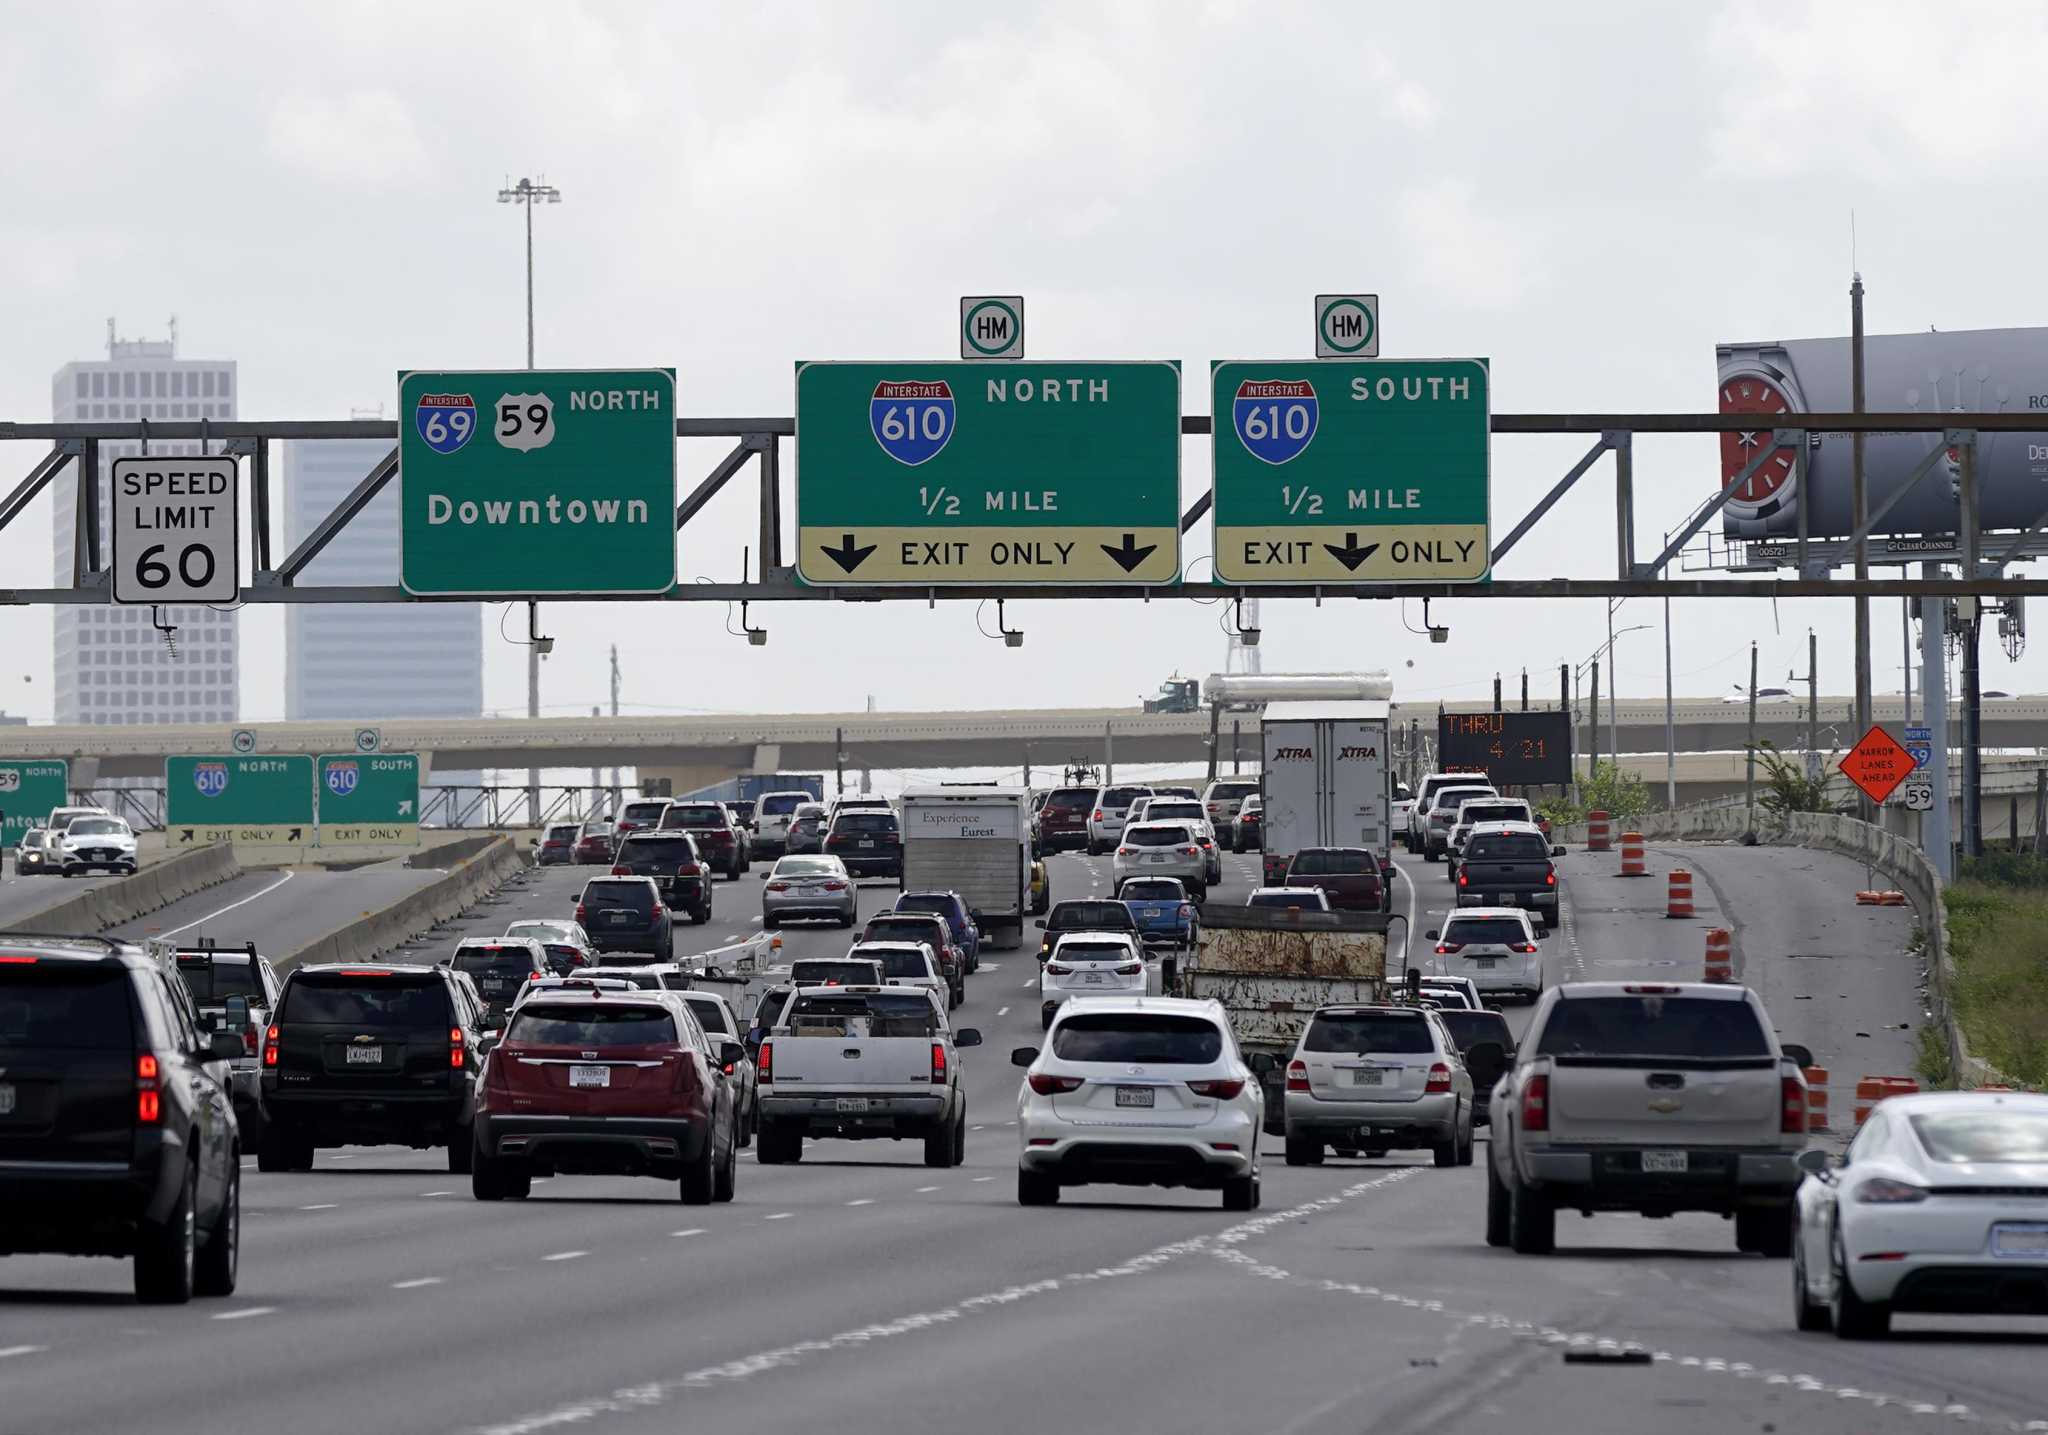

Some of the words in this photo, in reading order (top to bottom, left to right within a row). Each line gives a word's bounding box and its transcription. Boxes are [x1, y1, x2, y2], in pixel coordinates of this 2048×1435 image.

[977, 316, 1007, 341] HM
[1332, 314, 1362, 338] HM
[882, 385, 942, 398] INTERSTATE
[987, 379, 1109, 402] NORTH
[1246, 385, 1305, 397] INTERSTATE
[1350, 377, 1470, 401] SOUTH
[425, 396, 467, 406] INTERSTATE
[570, 390, 659, 410] NORTH
[425, 411, 471, 444] 69
[501, 404, 549, 437] 59
[881, 406, 946, 442] 610
[1245, 405, 1309, 441] 610
[123, 472, 227, 496] SPEED
[428, 493, 648, 525] Downtown
[985, 491, 1058, 511] MILE
[1348, 489, 1421, 509] MILE
[135, 505, 215, 530] LIMIT
[901, 542, 969, 566] EXIT
[991, 542, 1075, 566] ONLY
[1244, 542, 1312, 565] EXIT
[1391, 541, 1475, 564] ONLY
[135, 542, 216, 588] 60
[1444, 715, 1505, 735] THRU
[1272, 747, 1313, 761] XTRA
[1336, 746, 1377, 760] XTRA
[26, 767, 62, 777] NORTH
[239, 761, 288, 772] NORTH
[371, 760, 413, 771] SOUTH
[1860, 760, 1894, 769] LANES
[198, 770, 225, 790] 610
[329, 770, 356, 789] 610
[1863, 774, 1895, 782] AHEAD
[1908, 790, 1931, 804] 59
[923, 811, 980, 826] Experience
[206, 831, 233, 841] EXIT
[241, 830, 274, 840] ONLY
[335, 830, 361, 840] EXIT
[369, 829, 402, 840] ONLY
[961, 826, 995, 837] Eurest
